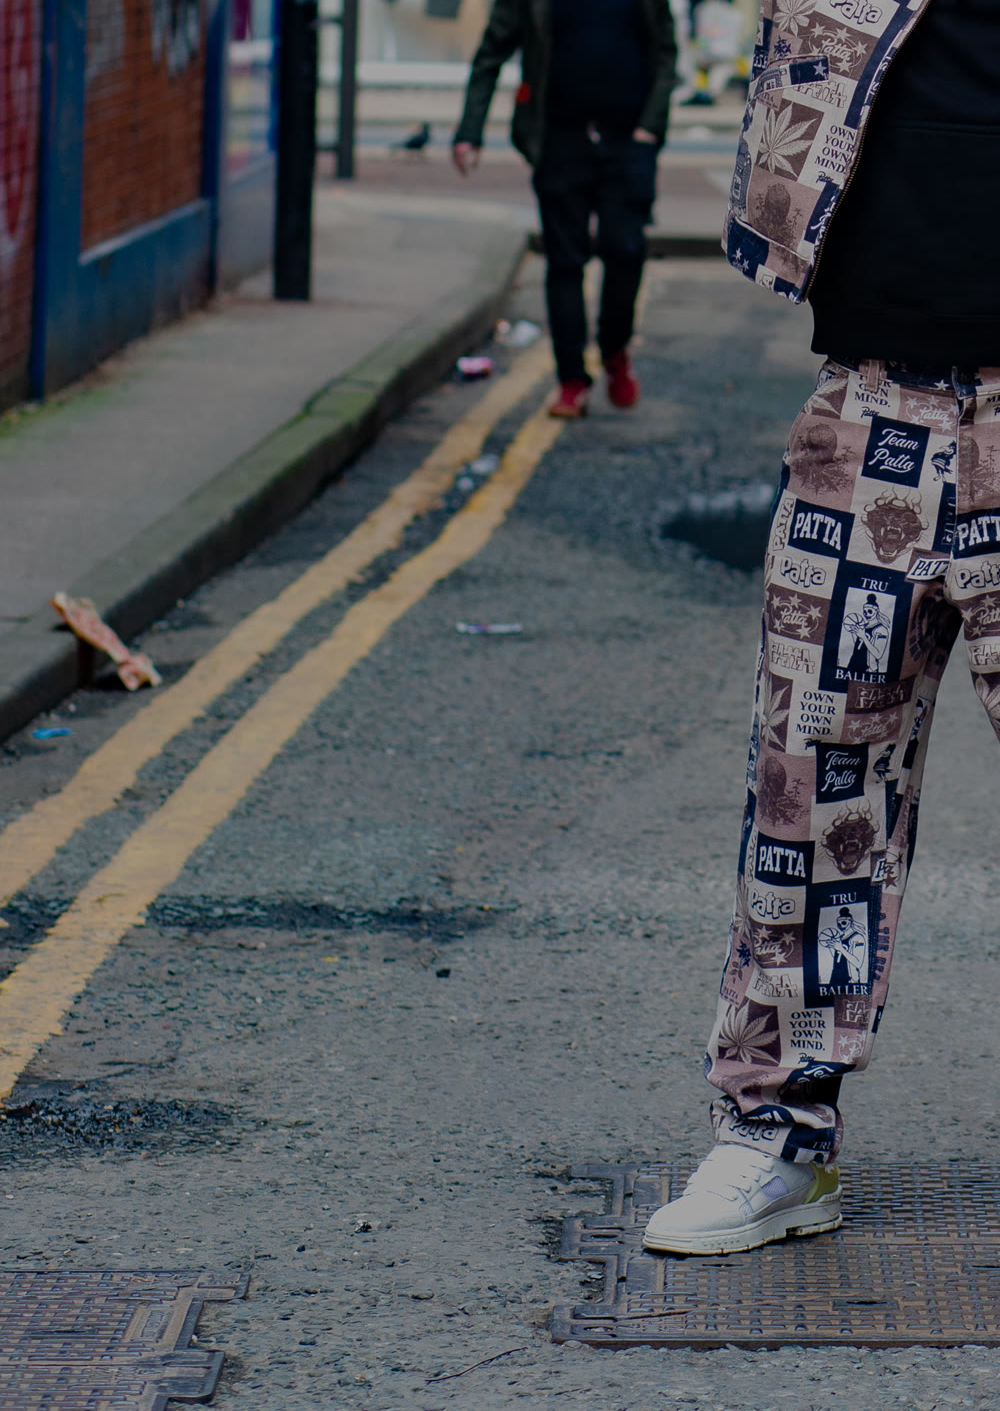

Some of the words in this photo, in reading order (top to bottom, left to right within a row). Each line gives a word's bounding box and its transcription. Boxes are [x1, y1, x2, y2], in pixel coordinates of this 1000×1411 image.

[820, 37, 852, 62] Patta
[830, 125, 856, 143] OWN
[825, 135, 855, 154] YOUR
[822, 147, 849, 163] OWN
[855, 391, 891, 407] MIND.
[919, 406, 951, 424] Patta
[878, 428, 919, 450] Team
[868, 448, 916, 474] Patta
[773, 497, 795, 551] PATTA
[792, 512, 843, 551] PATTA
[780, 556, 826, 587] Patta
[861, 577, 888, 592] TRU
[780, 603, 809, 626] Patta
[835, 668, 887, 684] BALLER
[803, 691, 835, 703] OWN
[800, 701, 836, 715] YOUR
[800, 713, 832, 725] OWN
[796, 724, 833, 736] MIND.
[825, 750, 862, 771] Team
[821, 770, 857, 792] Patta
[757, 845, 806, 878] PATTA
[750, 888, 796, 920] Patta
[830, 892, 857, 905] TRU
[818, 983, 870, 997] BALLER
[791, 1010, 823, 1020] OWN
[789, 1019, 826, 1029] YOUR
[792, 1030, 824, 1040] OWN
[790, 1039, 825, 1051] MIND.
